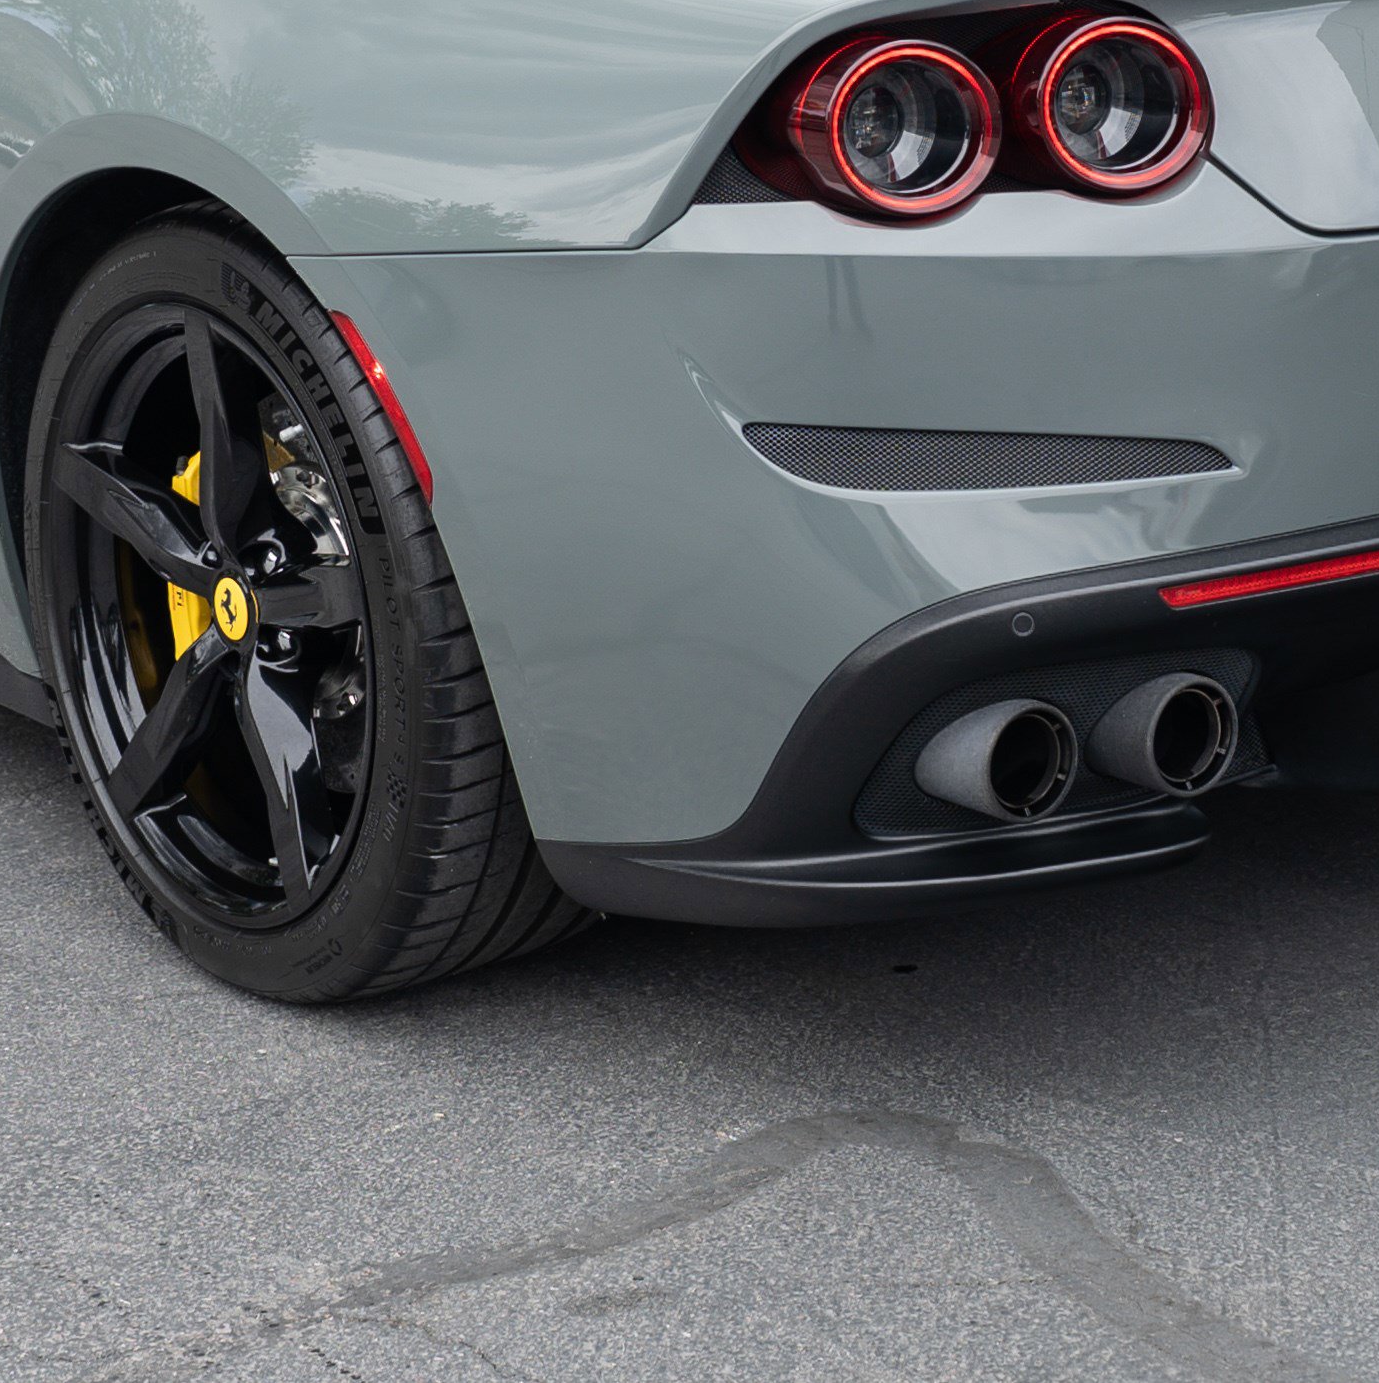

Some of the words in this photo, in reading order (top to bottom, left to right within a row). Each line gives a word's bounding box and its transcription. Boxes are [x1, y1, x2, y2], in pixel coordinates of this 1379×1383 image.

[254, 299, 380, 519] MICHELIN
[379, 557, 401, 633] PILOT
[390, 642, 406, 731] SPORT
